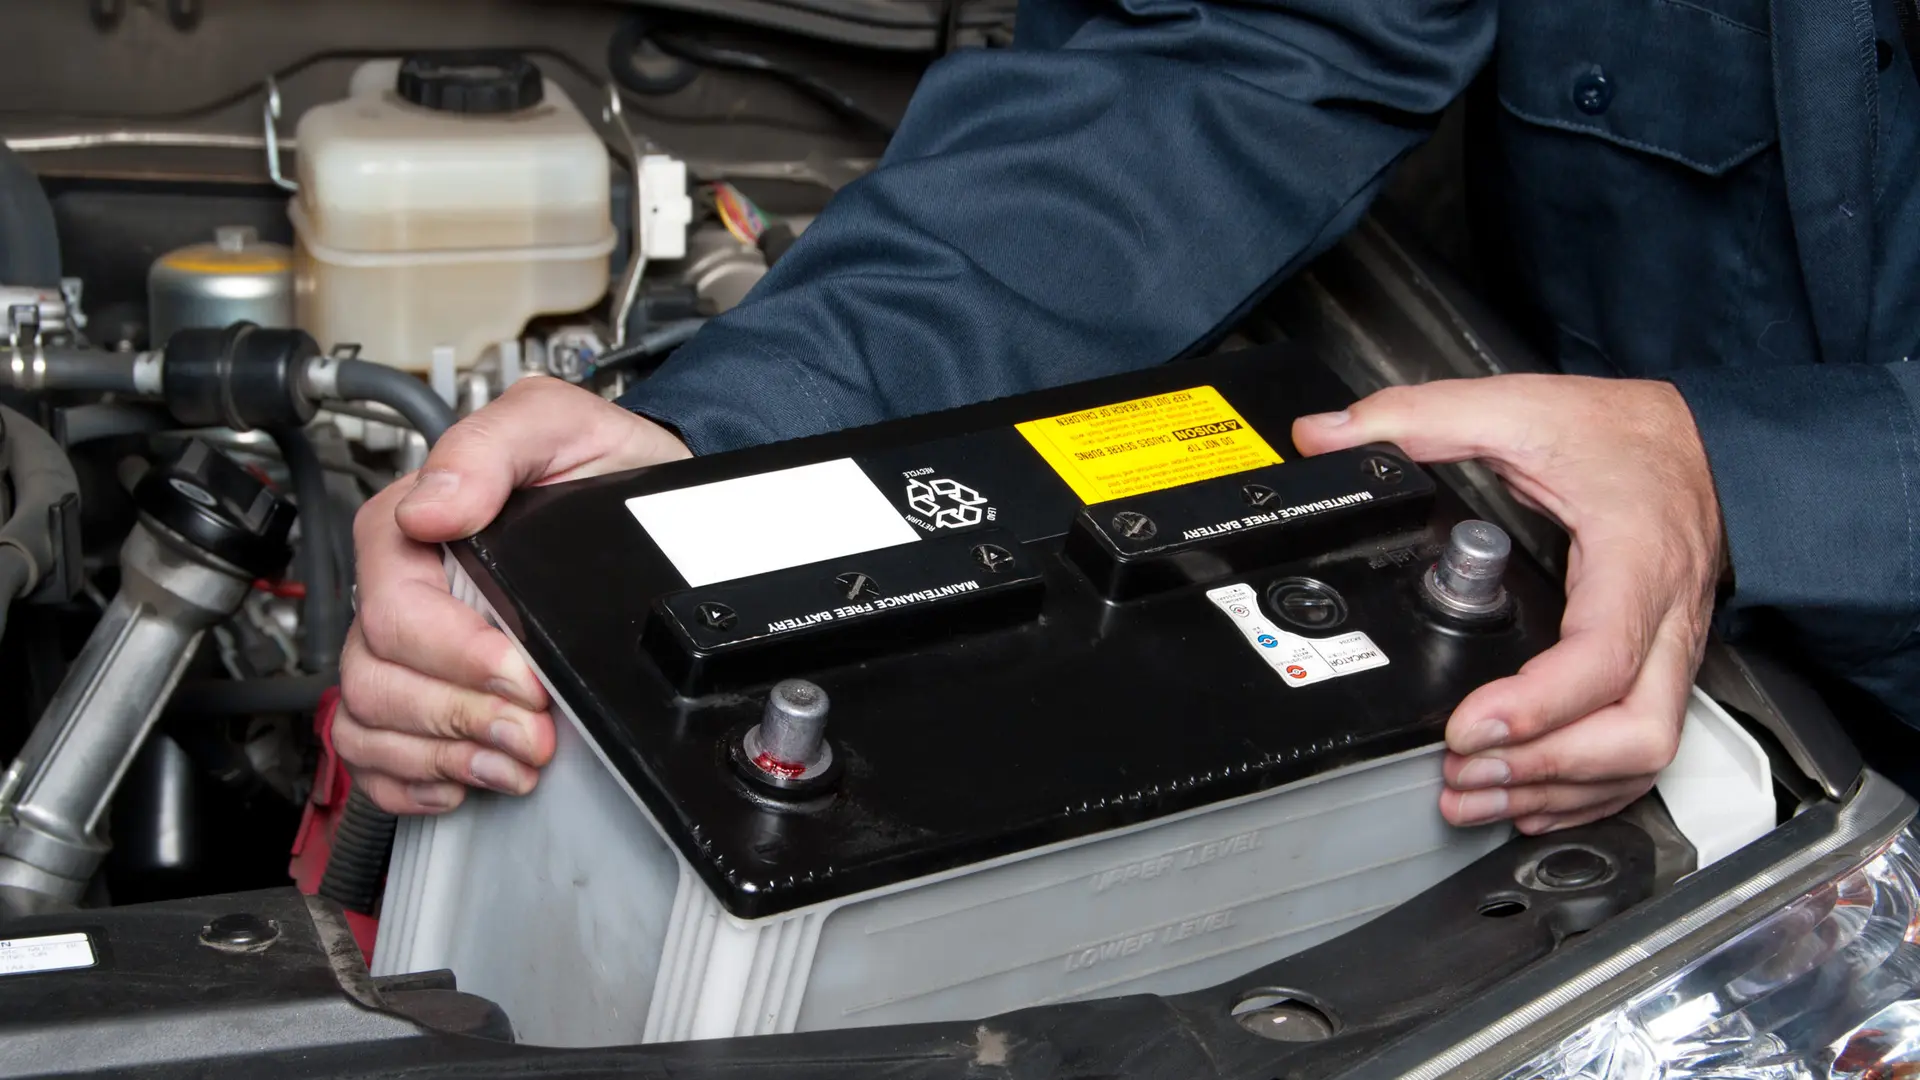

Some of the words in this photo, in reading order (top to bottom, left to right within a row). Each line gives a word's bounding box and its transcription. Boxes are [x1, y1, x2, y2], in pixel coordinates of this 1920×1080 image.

[1153, 397, 1172, 406] OUT
[1173, 392, 1192, 402] KEEP
[1111, 403, 1140, 414] REACH
[1141, 400, 1153, 409] OF
[1056, 411, 1098, 426] CHILDREN
[1100, 408, 1112, 417] OF
[1174, 423, 1228, 439] POISON
[1137, 435, 1172, 447] CAUSES
[1203, 439, 1221, 449] NOT
[1221, 436, 1235, 445] DO
[1074, 448, 1106, 460] BURNS
[1106, 442, 1137, 454] SEVERE
[1187, 443, 1202, 452] TIP
[903, 467, 935, 478] RECYCLE
[1278, 491, 1373, 518] MAINTENANCE
[905, 514, 936, 532] RETURN
[1242, 512, 1278, 527] FREE
[1183, 520, 1242, 540] BATTERY
[874, 580, 979, 608] MAINTENANCE
[836, 602, 873, 618] FREE
[768, 610, 833, 632] BATTERY
[1330, 651, 1377, 666] INDICATOR
[1089, 855, 1175, 893] UPPER
[1182, 831, 1264, 870] LEVEL
[1065, 931, 1155, 973] LOWER
[1162, 910, 1237, 944] LEVEL
